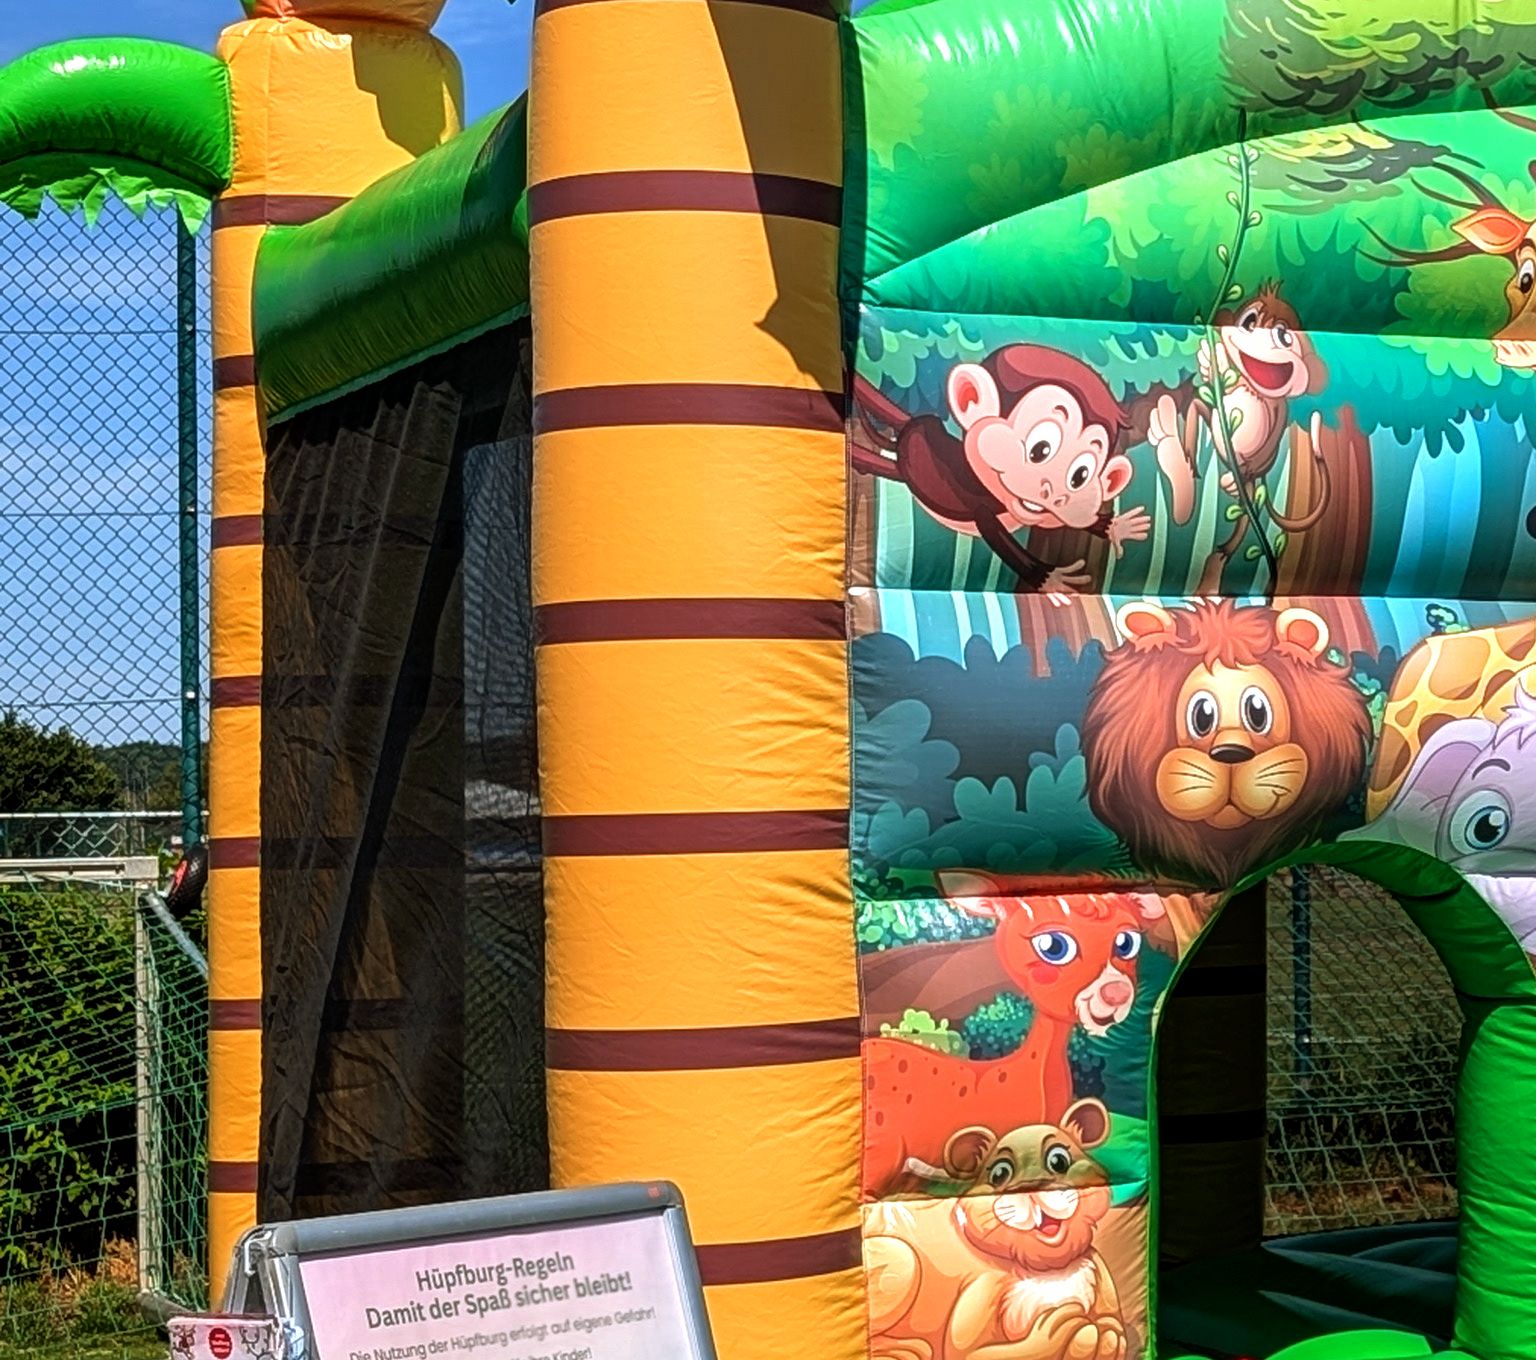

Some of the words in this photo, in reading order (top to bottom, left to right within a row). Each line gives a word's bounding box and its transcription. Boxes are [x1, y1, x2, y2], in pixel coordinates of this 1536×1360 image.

[415, 1251, 574, 1293] Hüpfburg-Regeln
[365, 1300, 426, 1328] Damit
[428, 1297, 460, 1319] der
[463, 1287, 511, 1317] Spaß
[514, 1282, 570, 1307] sicher
[572, 1271, 632, 1298] bleibt!
[427, 1339, 448, 1354] der
[449, 1331, 508, 1352] Hüpfburg
[508, 1323, 548, 1341] erfolgt
[550, 1318, 571, 1334] auf
[572, 1315, 612, 1333] eigene
[613, 1306, 656, 1324] Gefahr!
